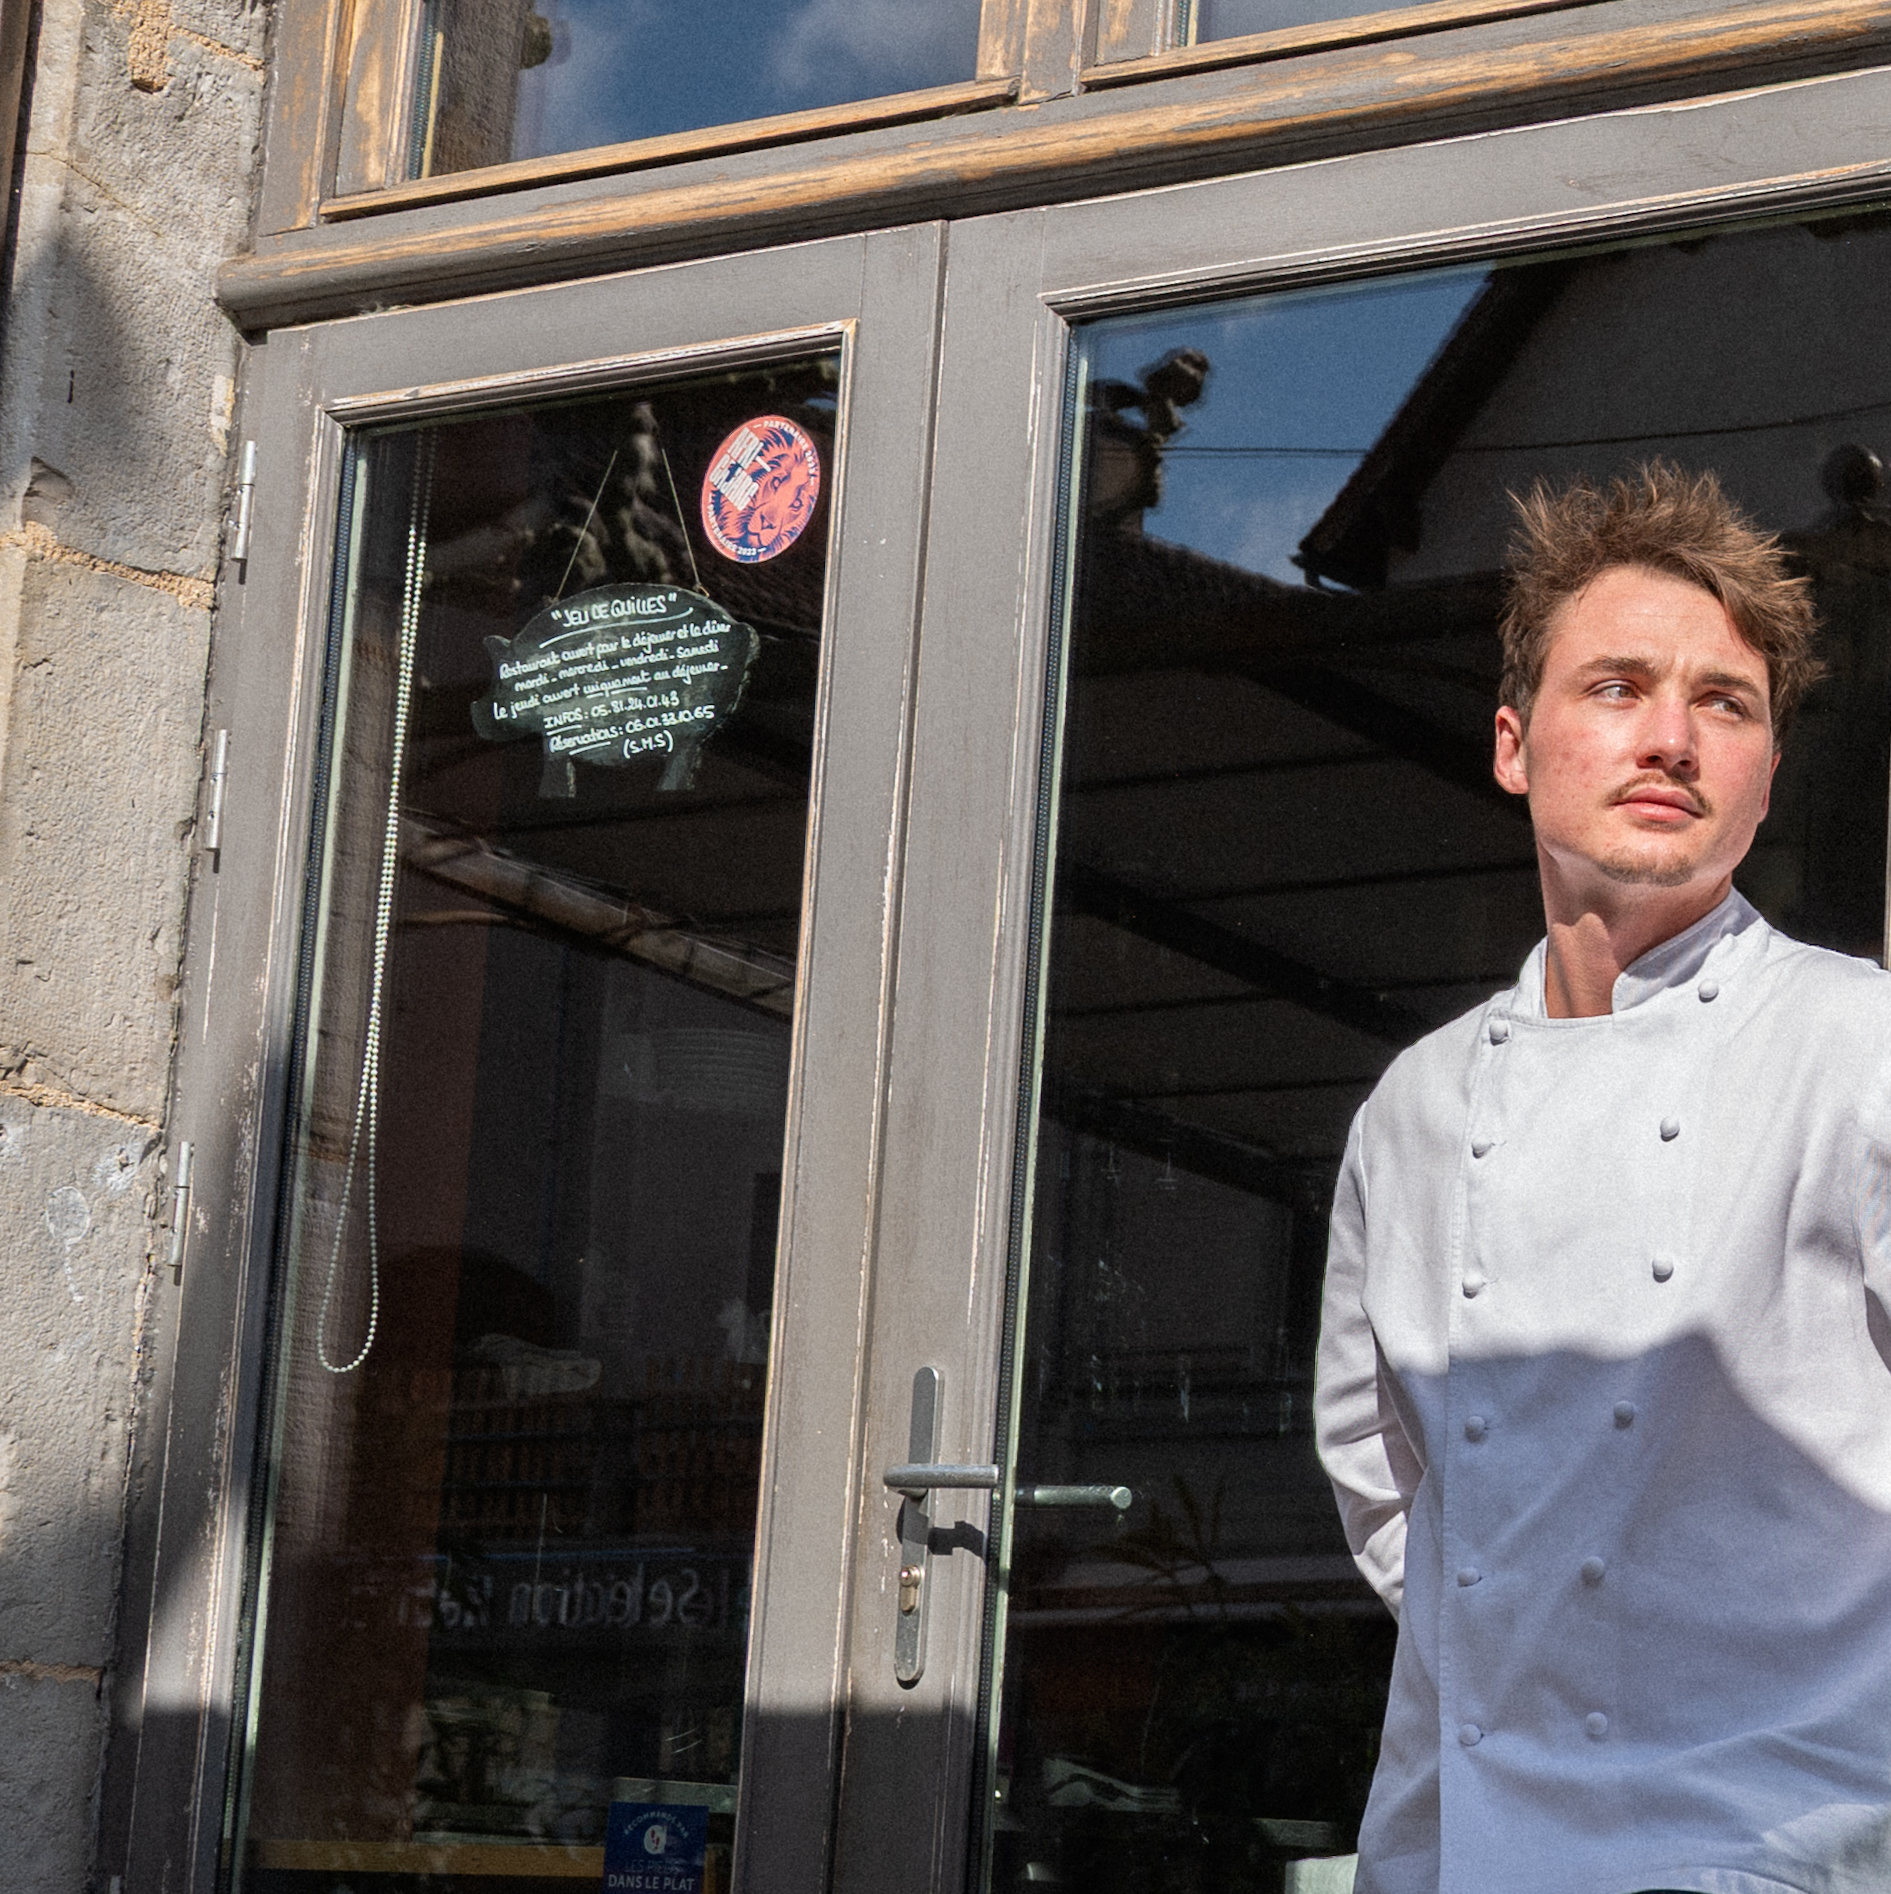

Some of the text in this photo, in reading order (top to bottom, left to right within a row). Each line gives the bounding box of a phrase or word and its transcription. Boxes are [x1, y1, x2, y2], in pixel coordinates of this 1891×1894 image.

[591, 603, 610, 619] DE
[500, 651, 562, 680] Restaurant
[561, 642, 595, 662] ouvert
[595, 641, 618, 659] pour
[621, 636, 633, 650] le
[632, 628, 676, 654] déjeuner
[677, 626, 690, 639] et
[690, 622, 702, 638] le
[514, 672, 550, 692] mardi
[558, 660, 610, 680] mercredi
[620, 648, 670, 667] vendredi
[510, 693, 540, 719] jeudi
[542, 683, 580, 704] ouvert
[583, 670, 652, 698] uniquement
[653, 669, 671, 681] au
[608, 1873, 695, 1892] DANS LE PLAT
